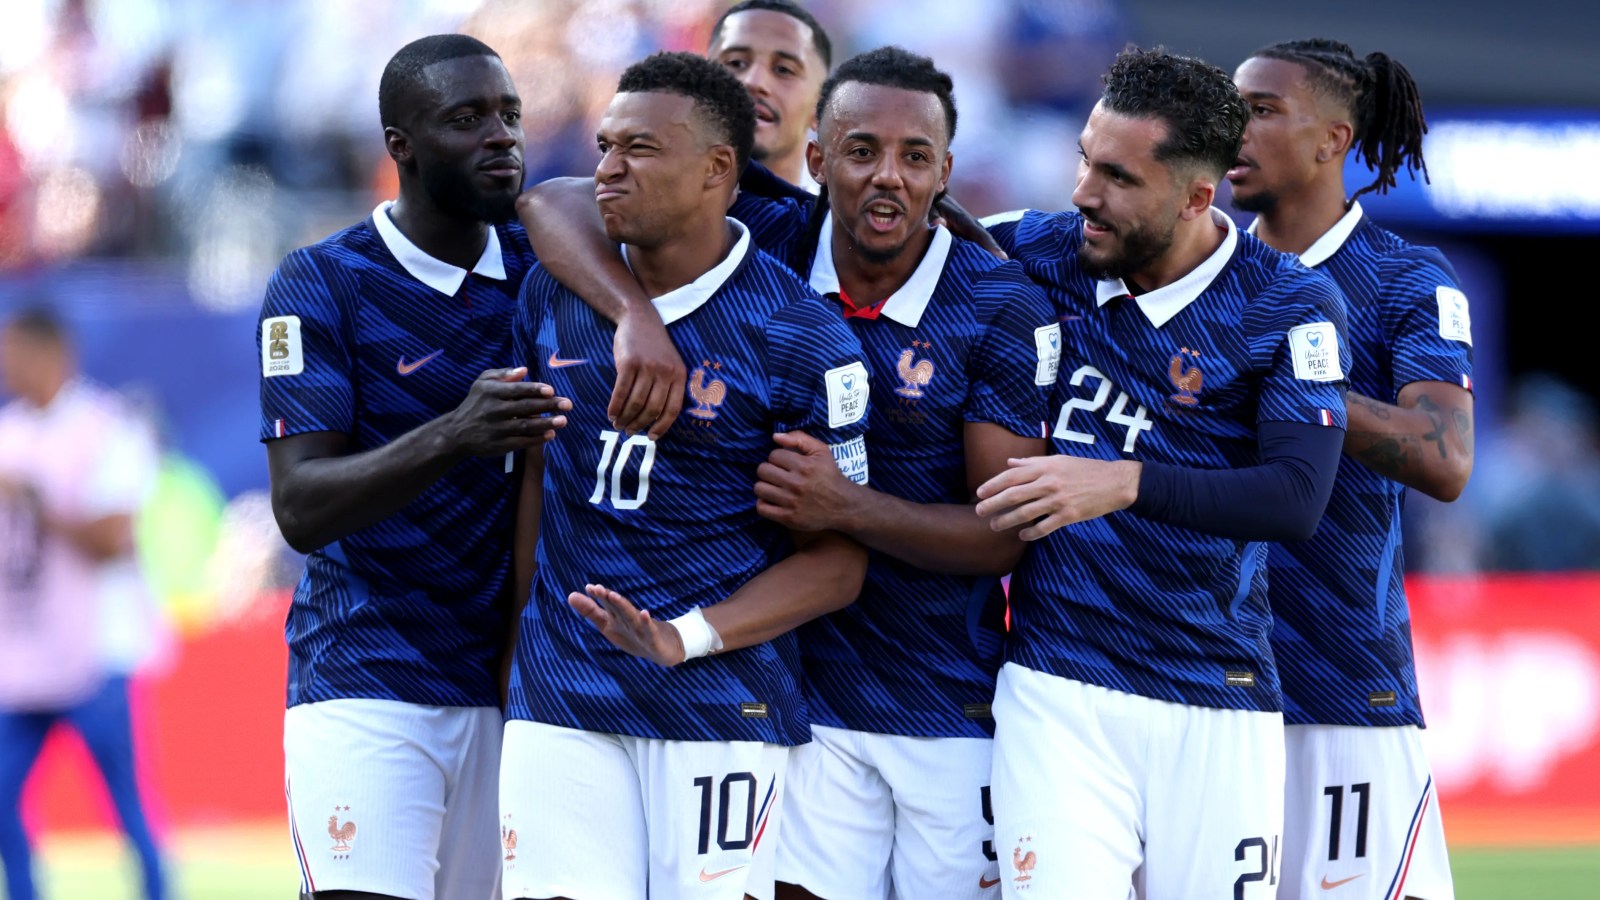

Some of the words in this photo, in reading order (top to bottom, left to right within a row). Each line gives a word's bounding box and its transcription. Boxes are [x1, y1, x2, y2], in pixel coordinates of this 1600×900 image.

[1308, 358, 1329, 370] PEACE
[841, 398, 859, 413] PEACE
[1053, 365, 1153, 453] 24
[588, 430, 656, 510] 10
[694, 771, 757, 855] 10
[1324, 782, 1370, 861] 11
